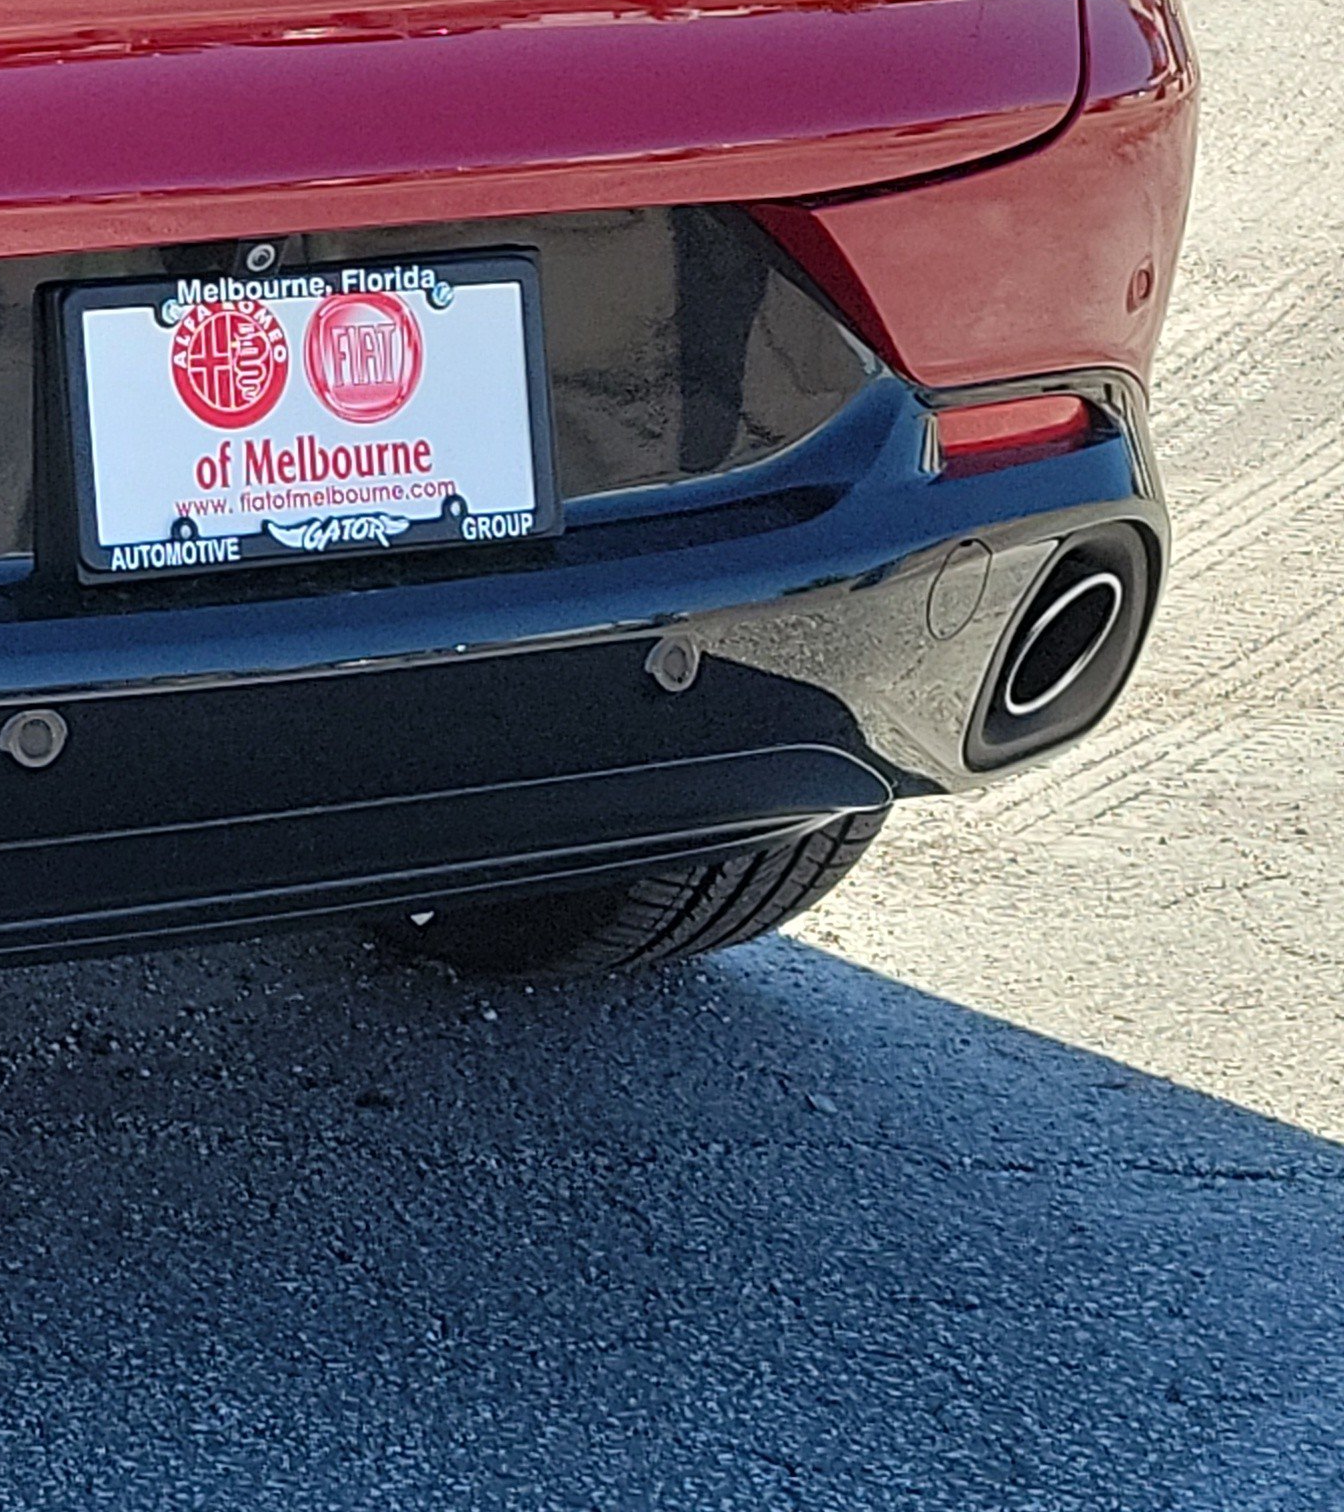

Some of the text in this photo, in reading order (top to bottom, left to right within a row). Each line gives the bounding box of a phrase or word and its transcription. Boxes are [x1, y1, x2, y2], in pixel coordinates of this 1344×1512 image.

[177, 265, 436, 305] Melbourne, Florida
[173, 304, 213, 369] ALFA
[330, 322, 397, 387] FIAT
[196, 435, 433, 490] of Melbourne
[111, 513, 534, 571] AUTOMOTIVE GROUP
[302, 516, 390, 551] GATOR
